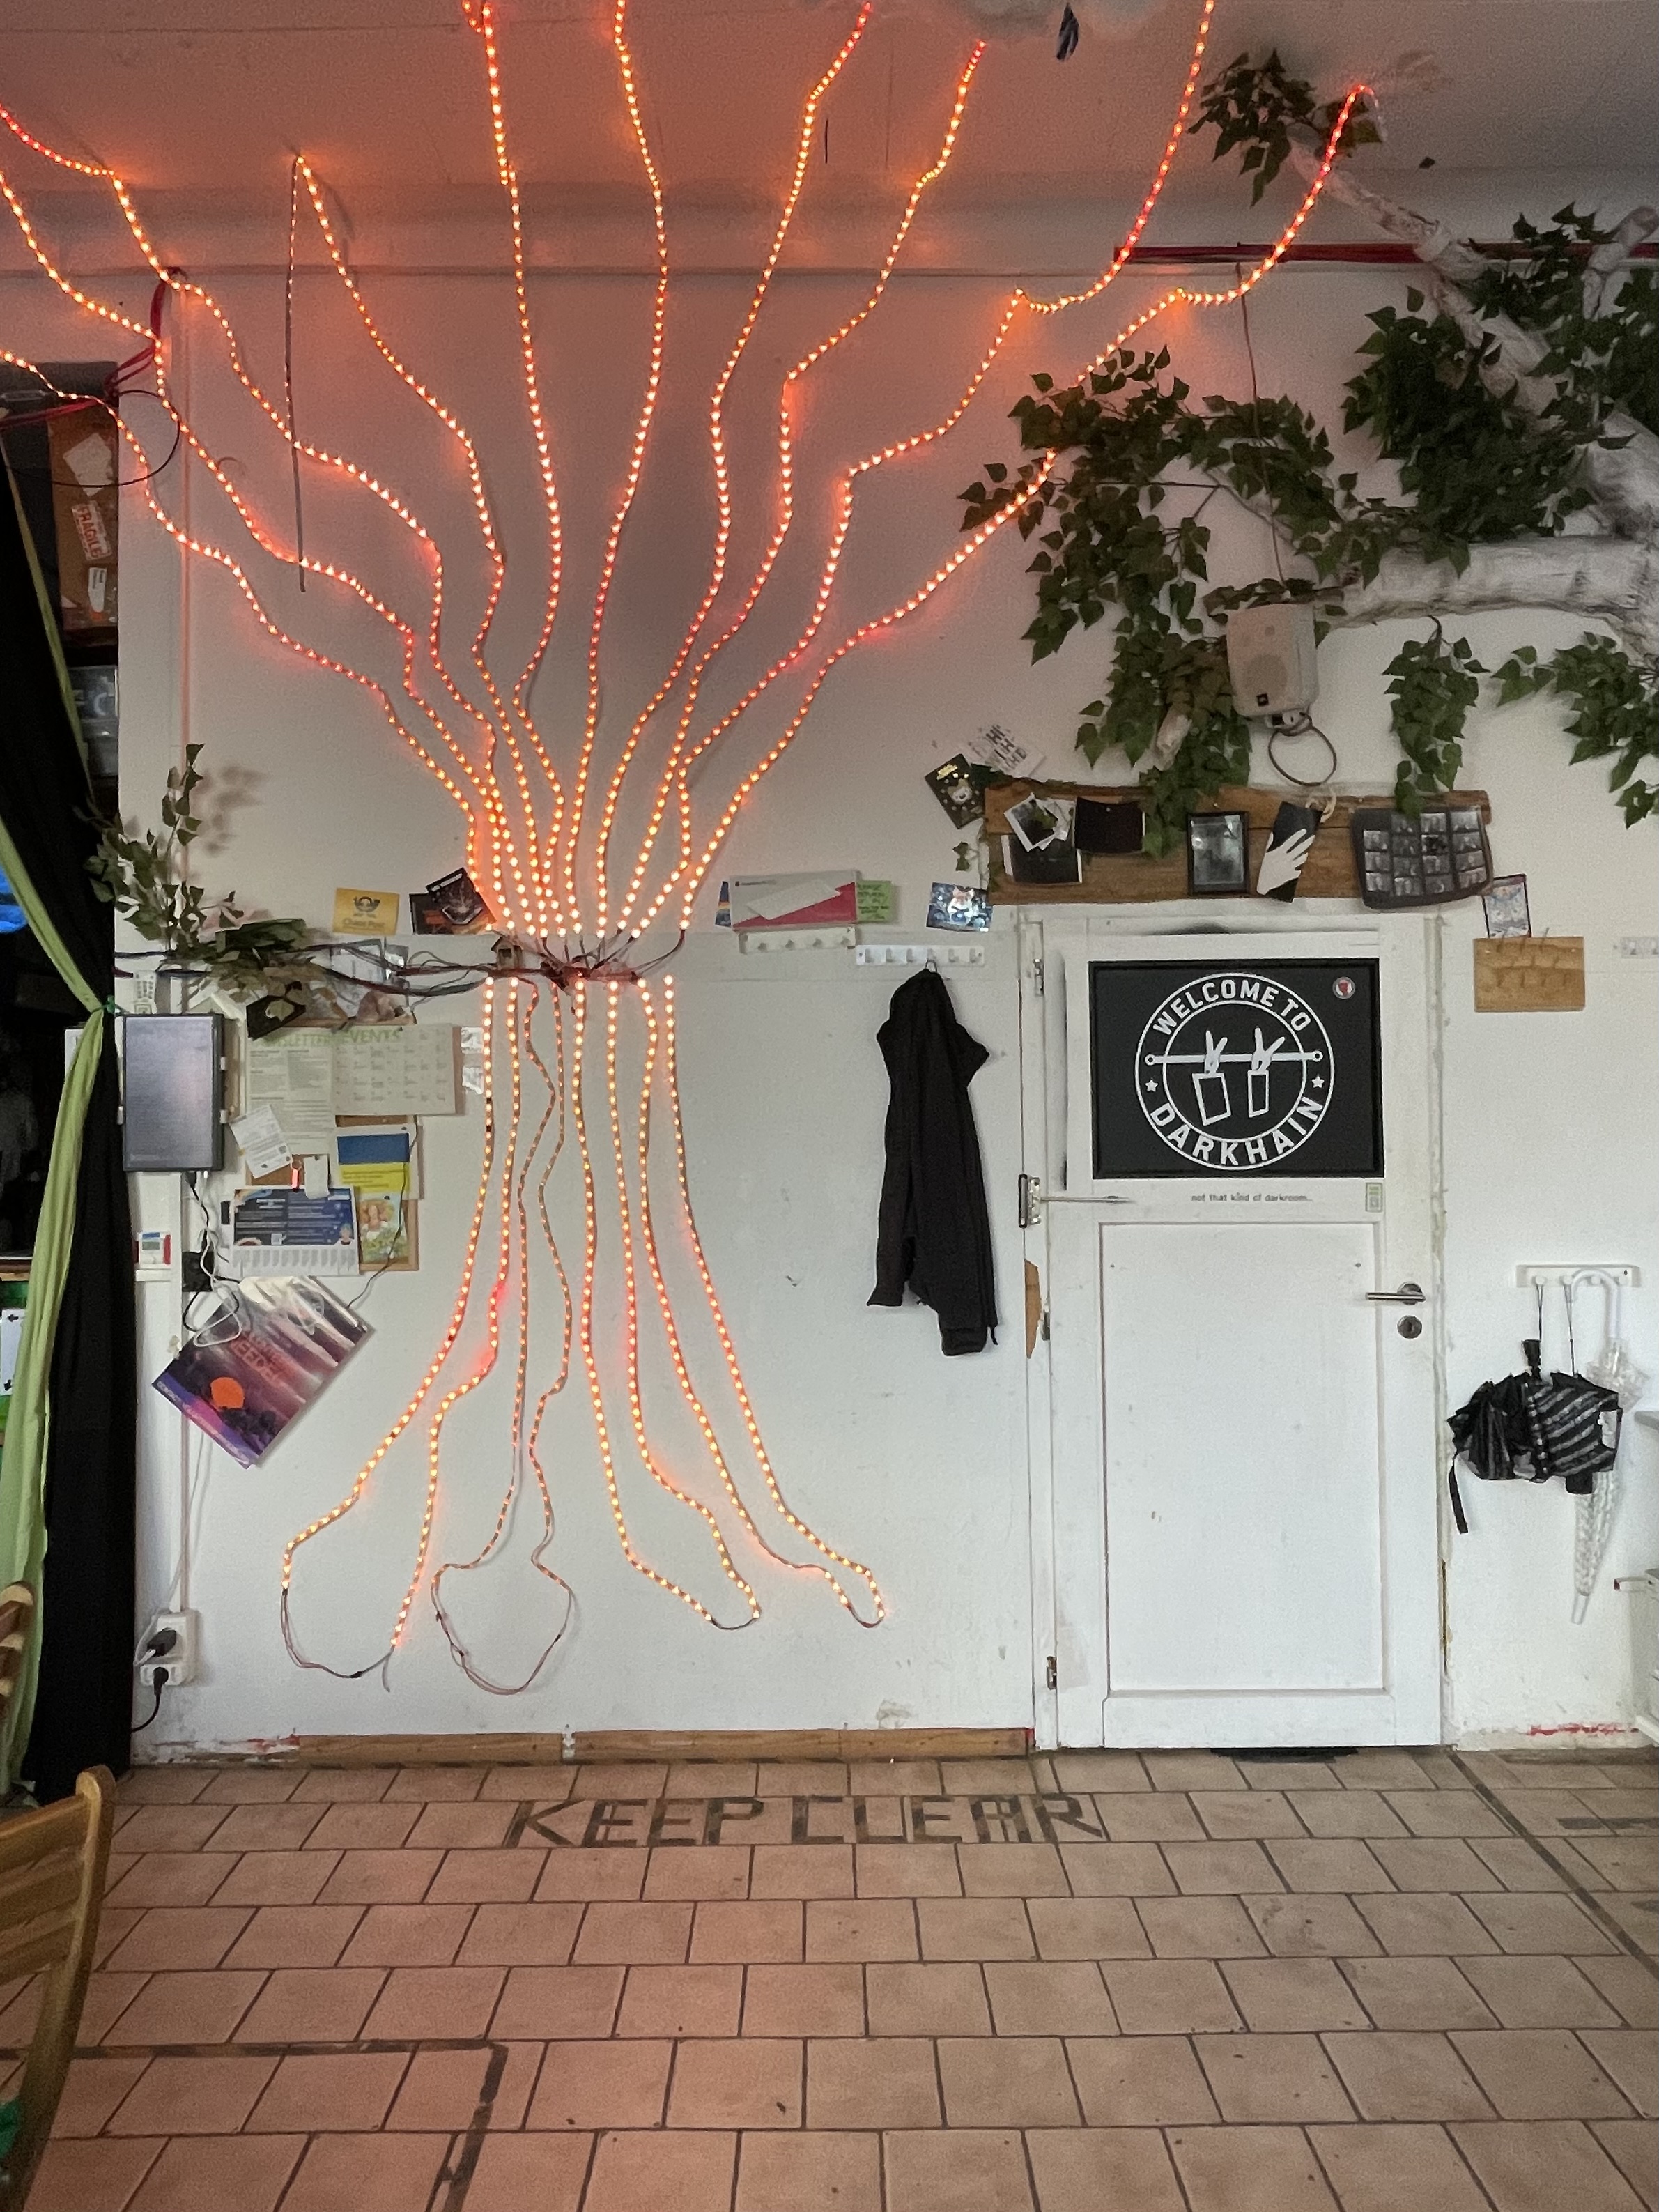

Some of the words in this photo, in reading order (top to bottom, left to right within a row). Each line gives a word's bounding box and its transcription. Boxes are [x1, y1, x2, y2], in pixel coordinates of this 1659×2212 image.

[77, 507, 103, 558] FRAGILE
[1152, 979, 1279, 1035] WELCOME
[1281, 997, 1311, 1031] TO
[1150, 1096, 1324, 1166] DARKHAIN
[1231, 1192, 1249, 1201] kind
[503, 1797, 764, 1848] KEEP
[791, 1792, 1104, 1844] CLEAR
